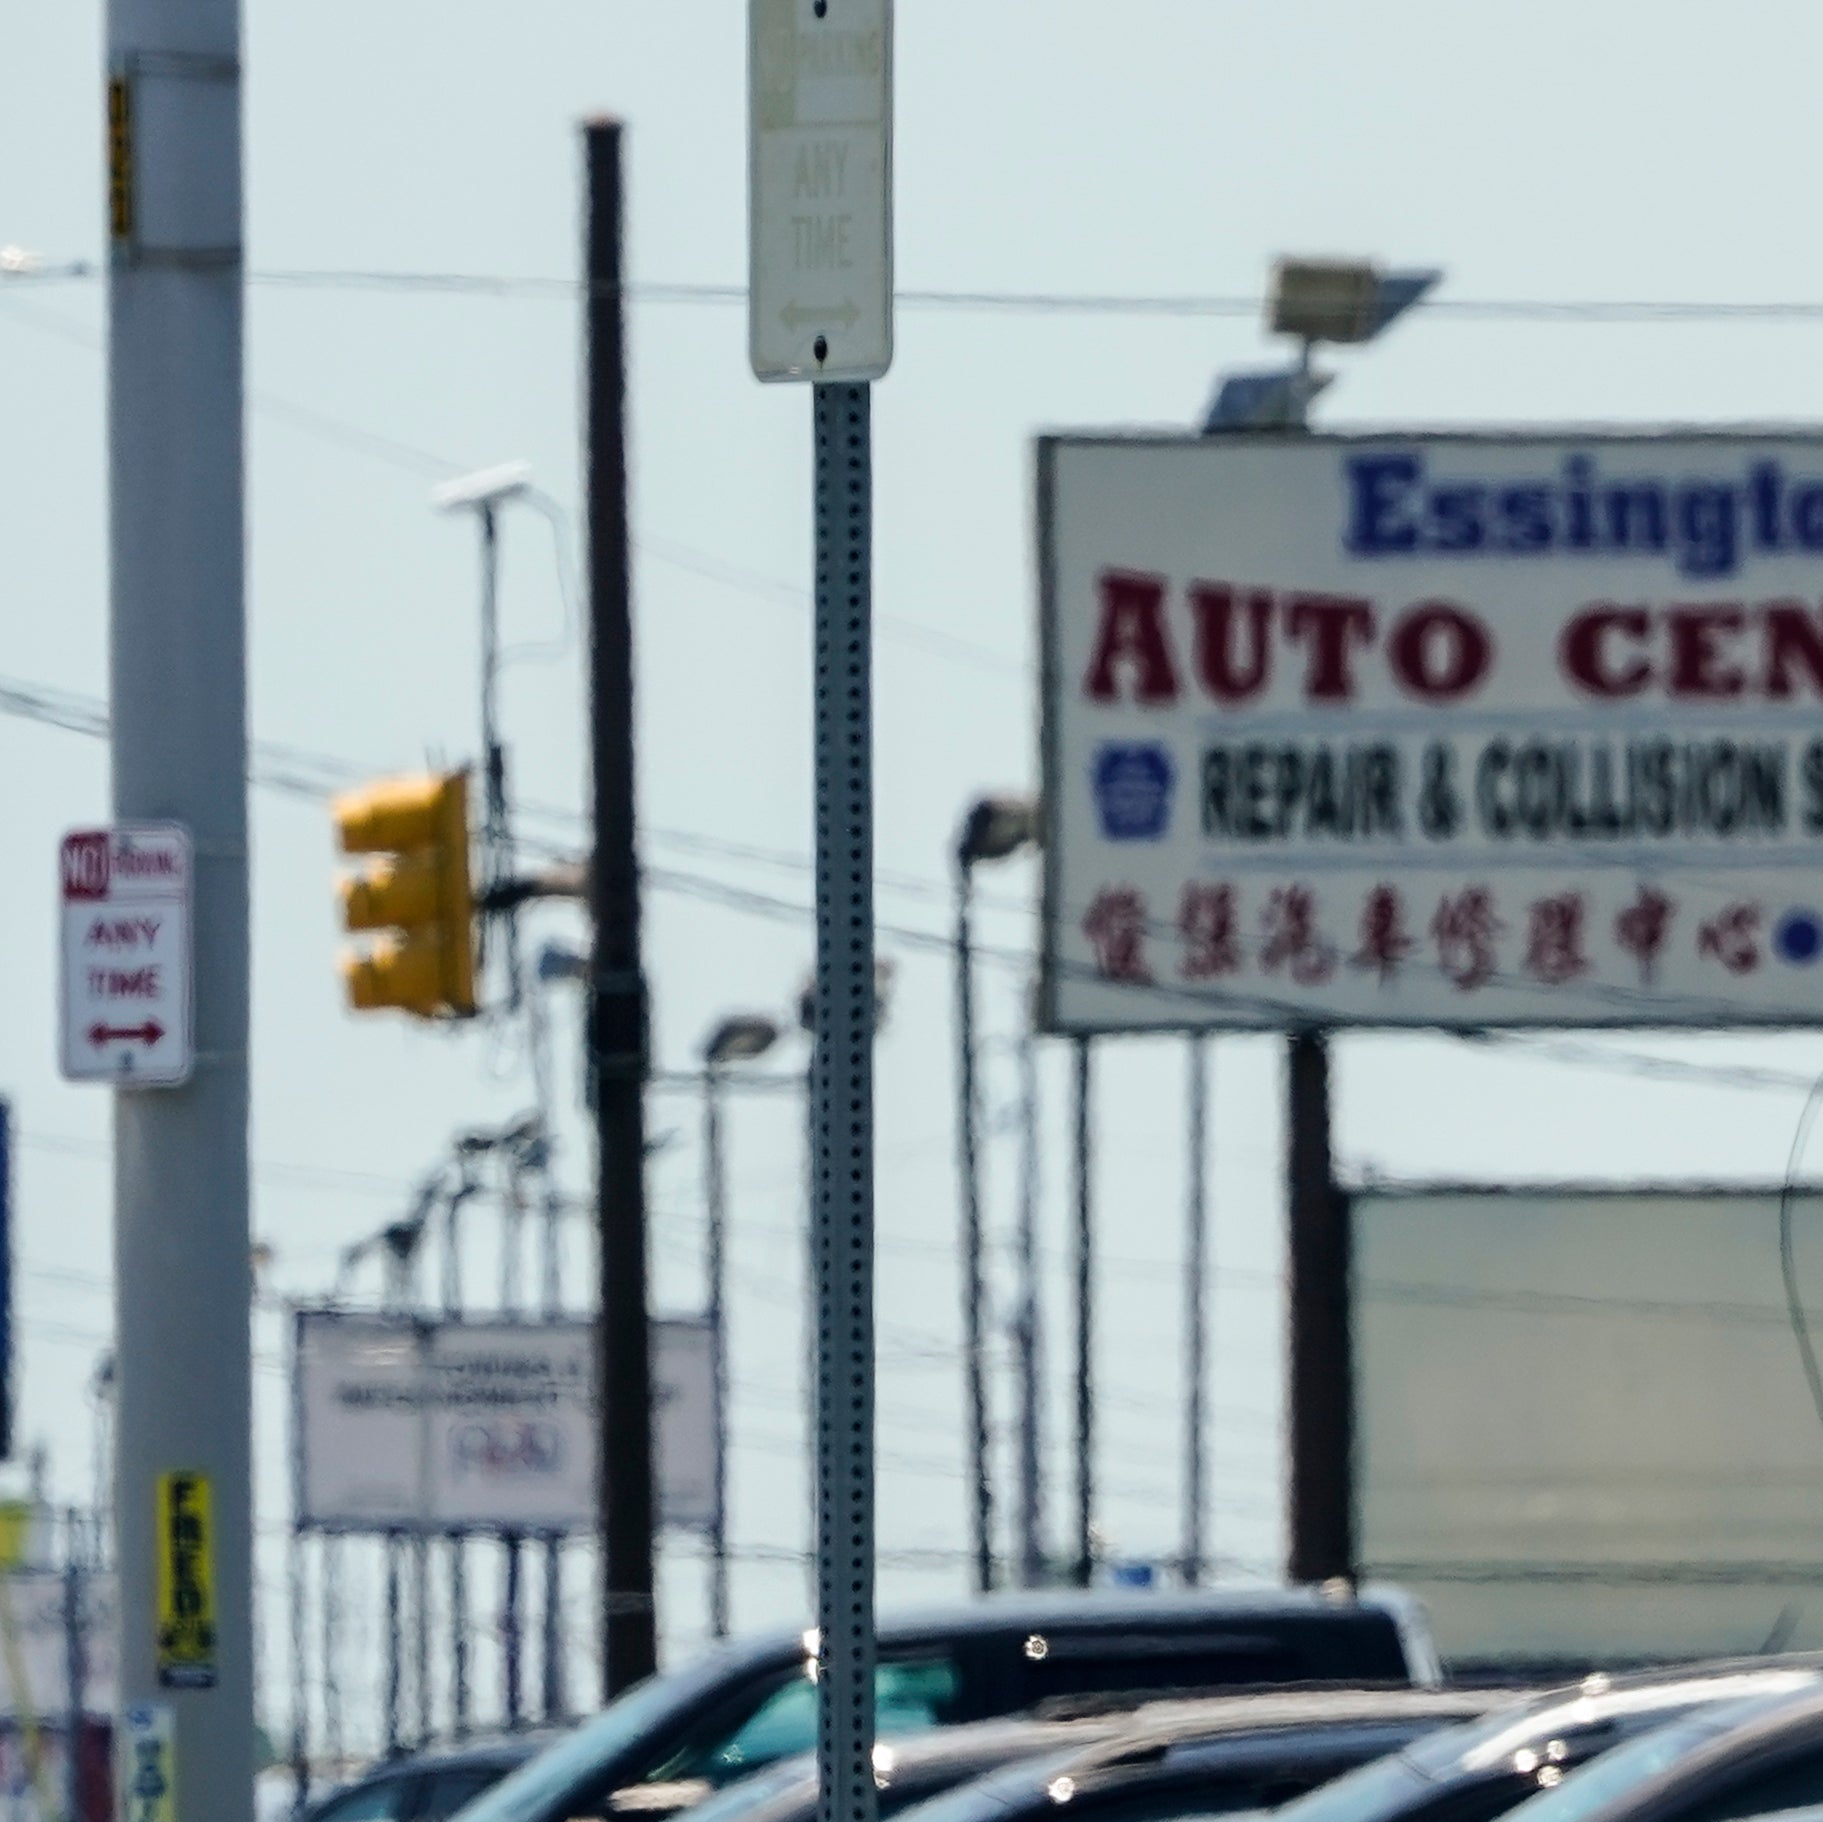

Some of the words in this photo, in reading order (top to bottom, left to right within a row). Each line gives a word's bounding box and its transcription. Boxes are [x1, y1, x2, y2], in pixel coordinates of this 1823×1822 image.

[1083, 566, 1496, 708] AUTO
[1201, 740, 1402, 842] REPAIR
[1417, 739, 1463, 842] &
[1476, 738, 1788, 842] COLLISION
[89, 917, 161, 950] ANY
[88, 964, 159, 999] TIME
